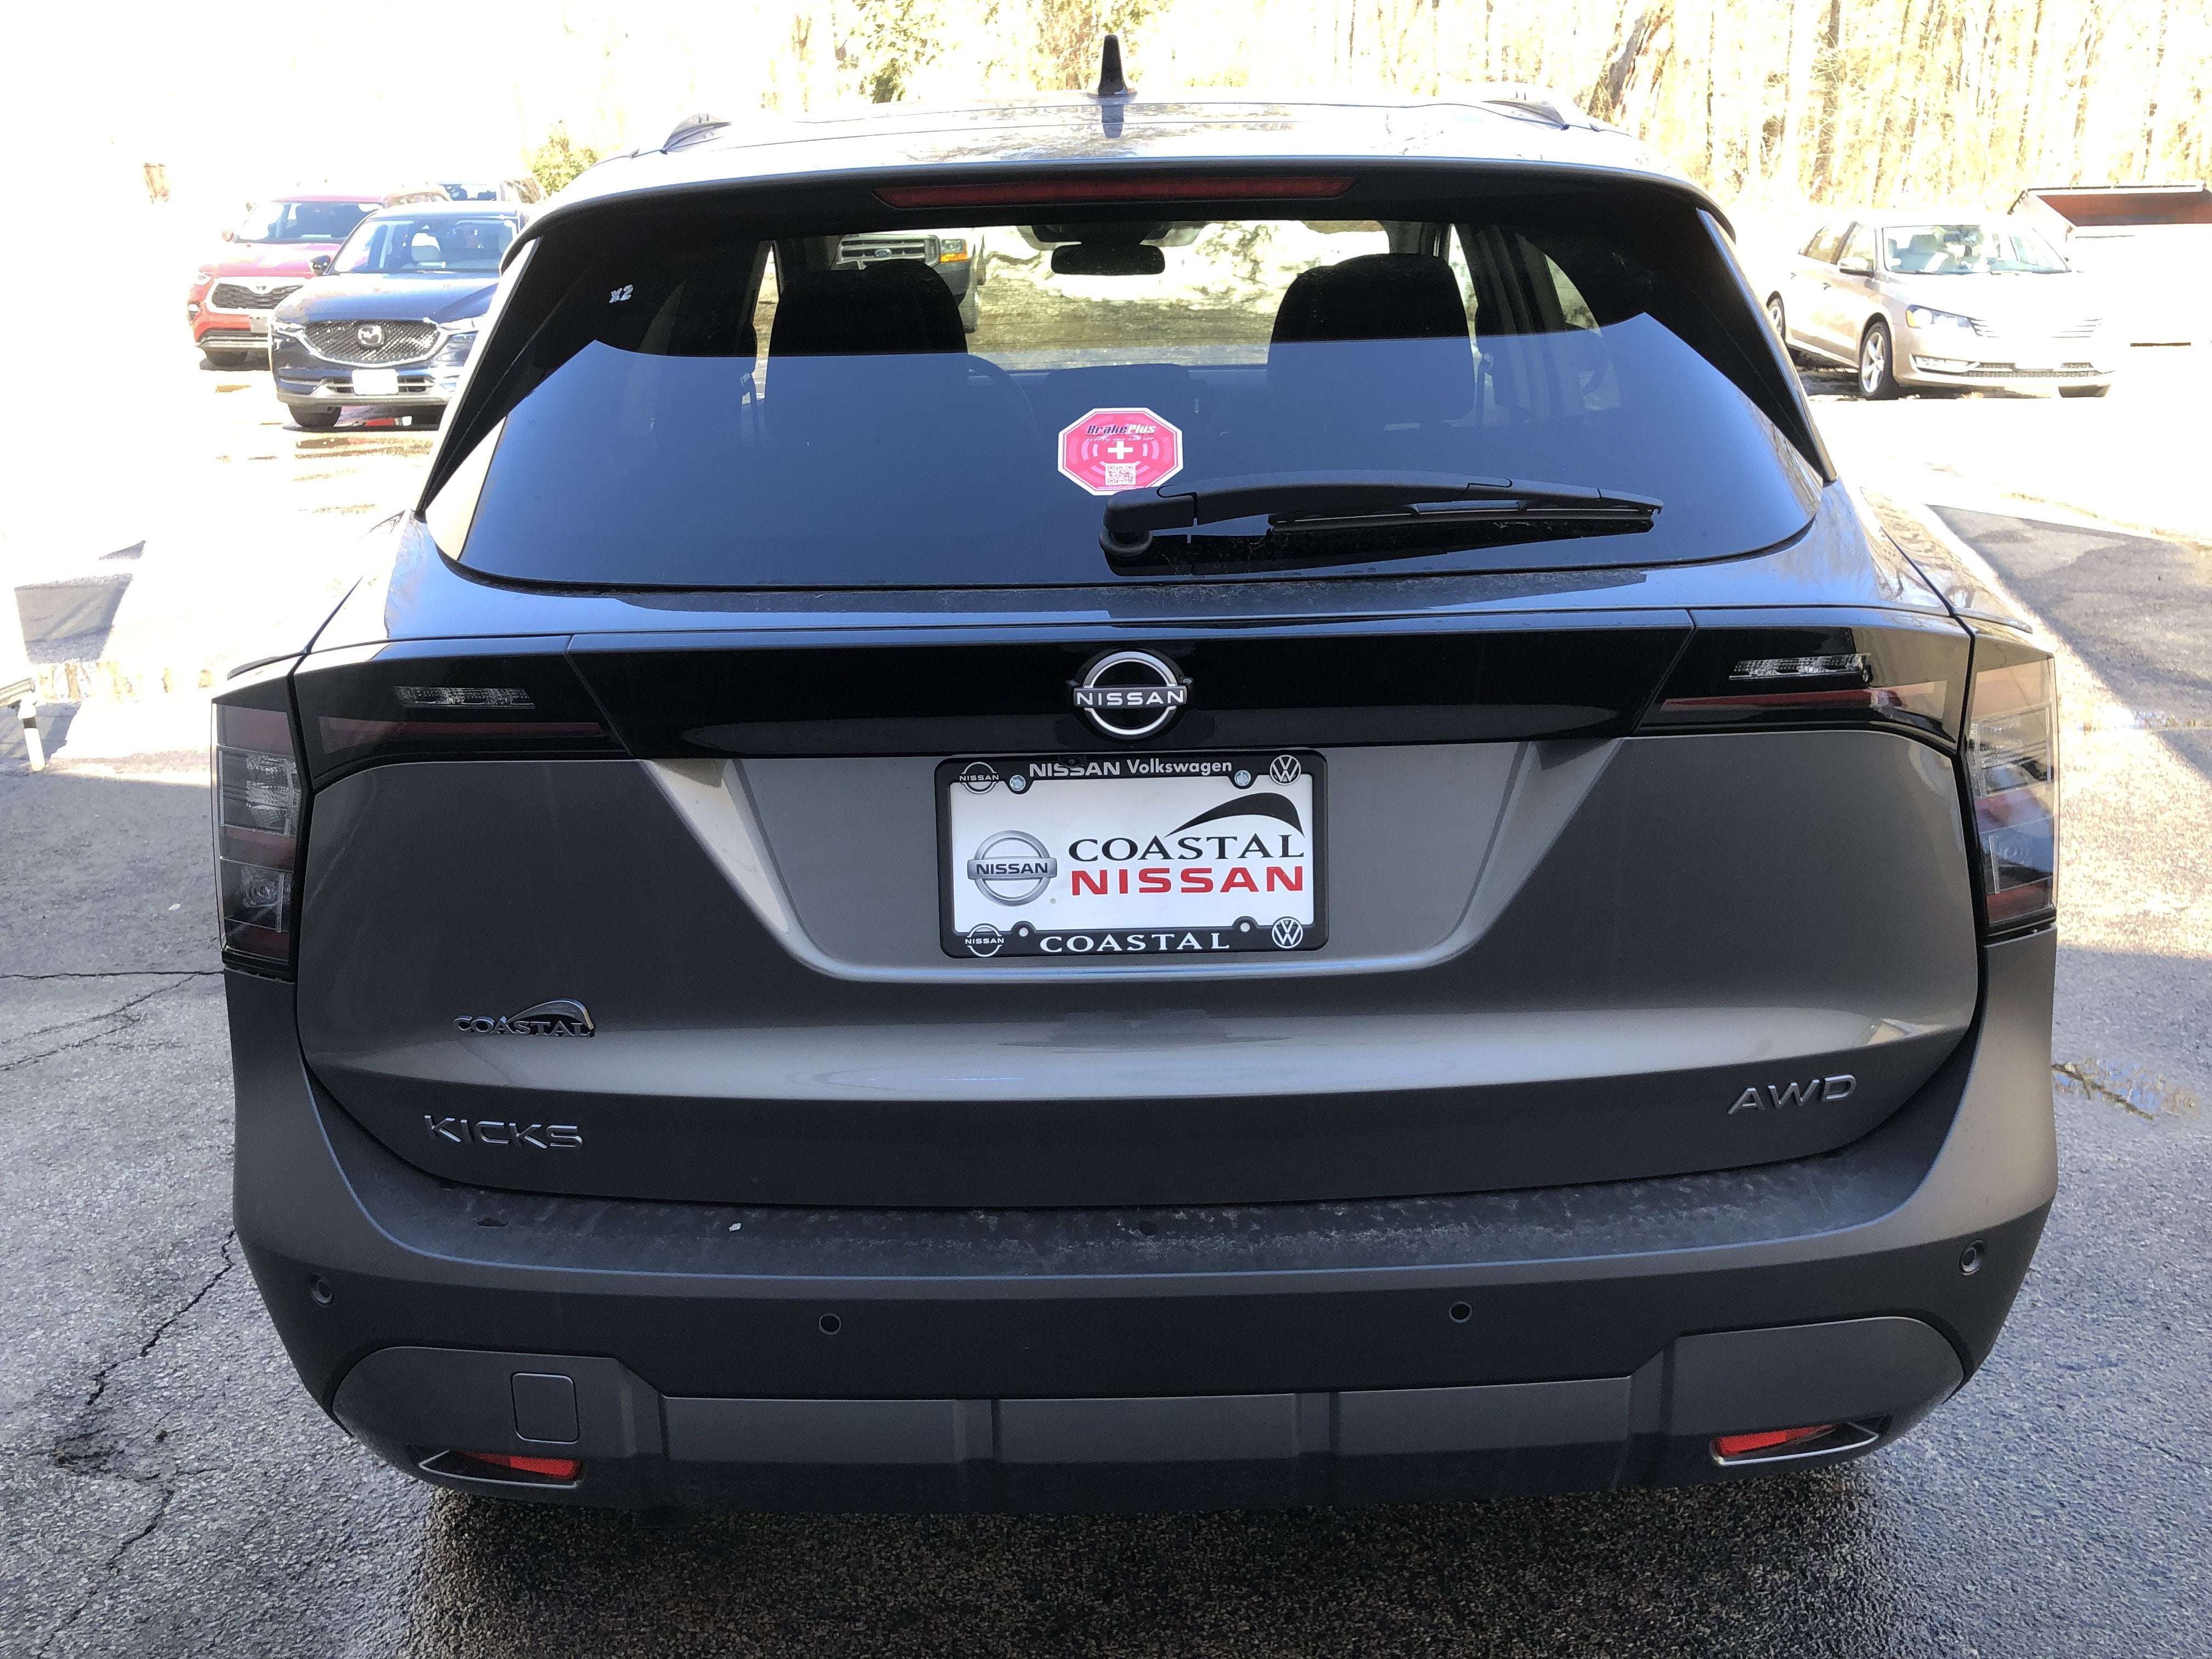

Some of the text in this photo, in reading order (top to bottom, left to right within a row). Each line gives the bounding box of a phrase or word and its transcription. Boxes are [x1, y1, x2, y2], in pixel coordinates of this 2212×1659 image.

[1086, 424, 1156, 434] BrakePlus
[1076, 690, 1184, 706] NISSAN
[1029, 759, 1232, 777] NISSAN Volkswagen
[1069, 833, 1304, 862] COASTAL
[977, 862, 1048, 875] NISSAN
[1071, 865, 1304, 896] NISSAN
[1040, 932, 1230, 953] COASTAL
[453, 1015, 592, 1038] COASTAL
[1728, 1074, 1857, 1115] AWD
[424, 1114, 584, 1149] KICKS
